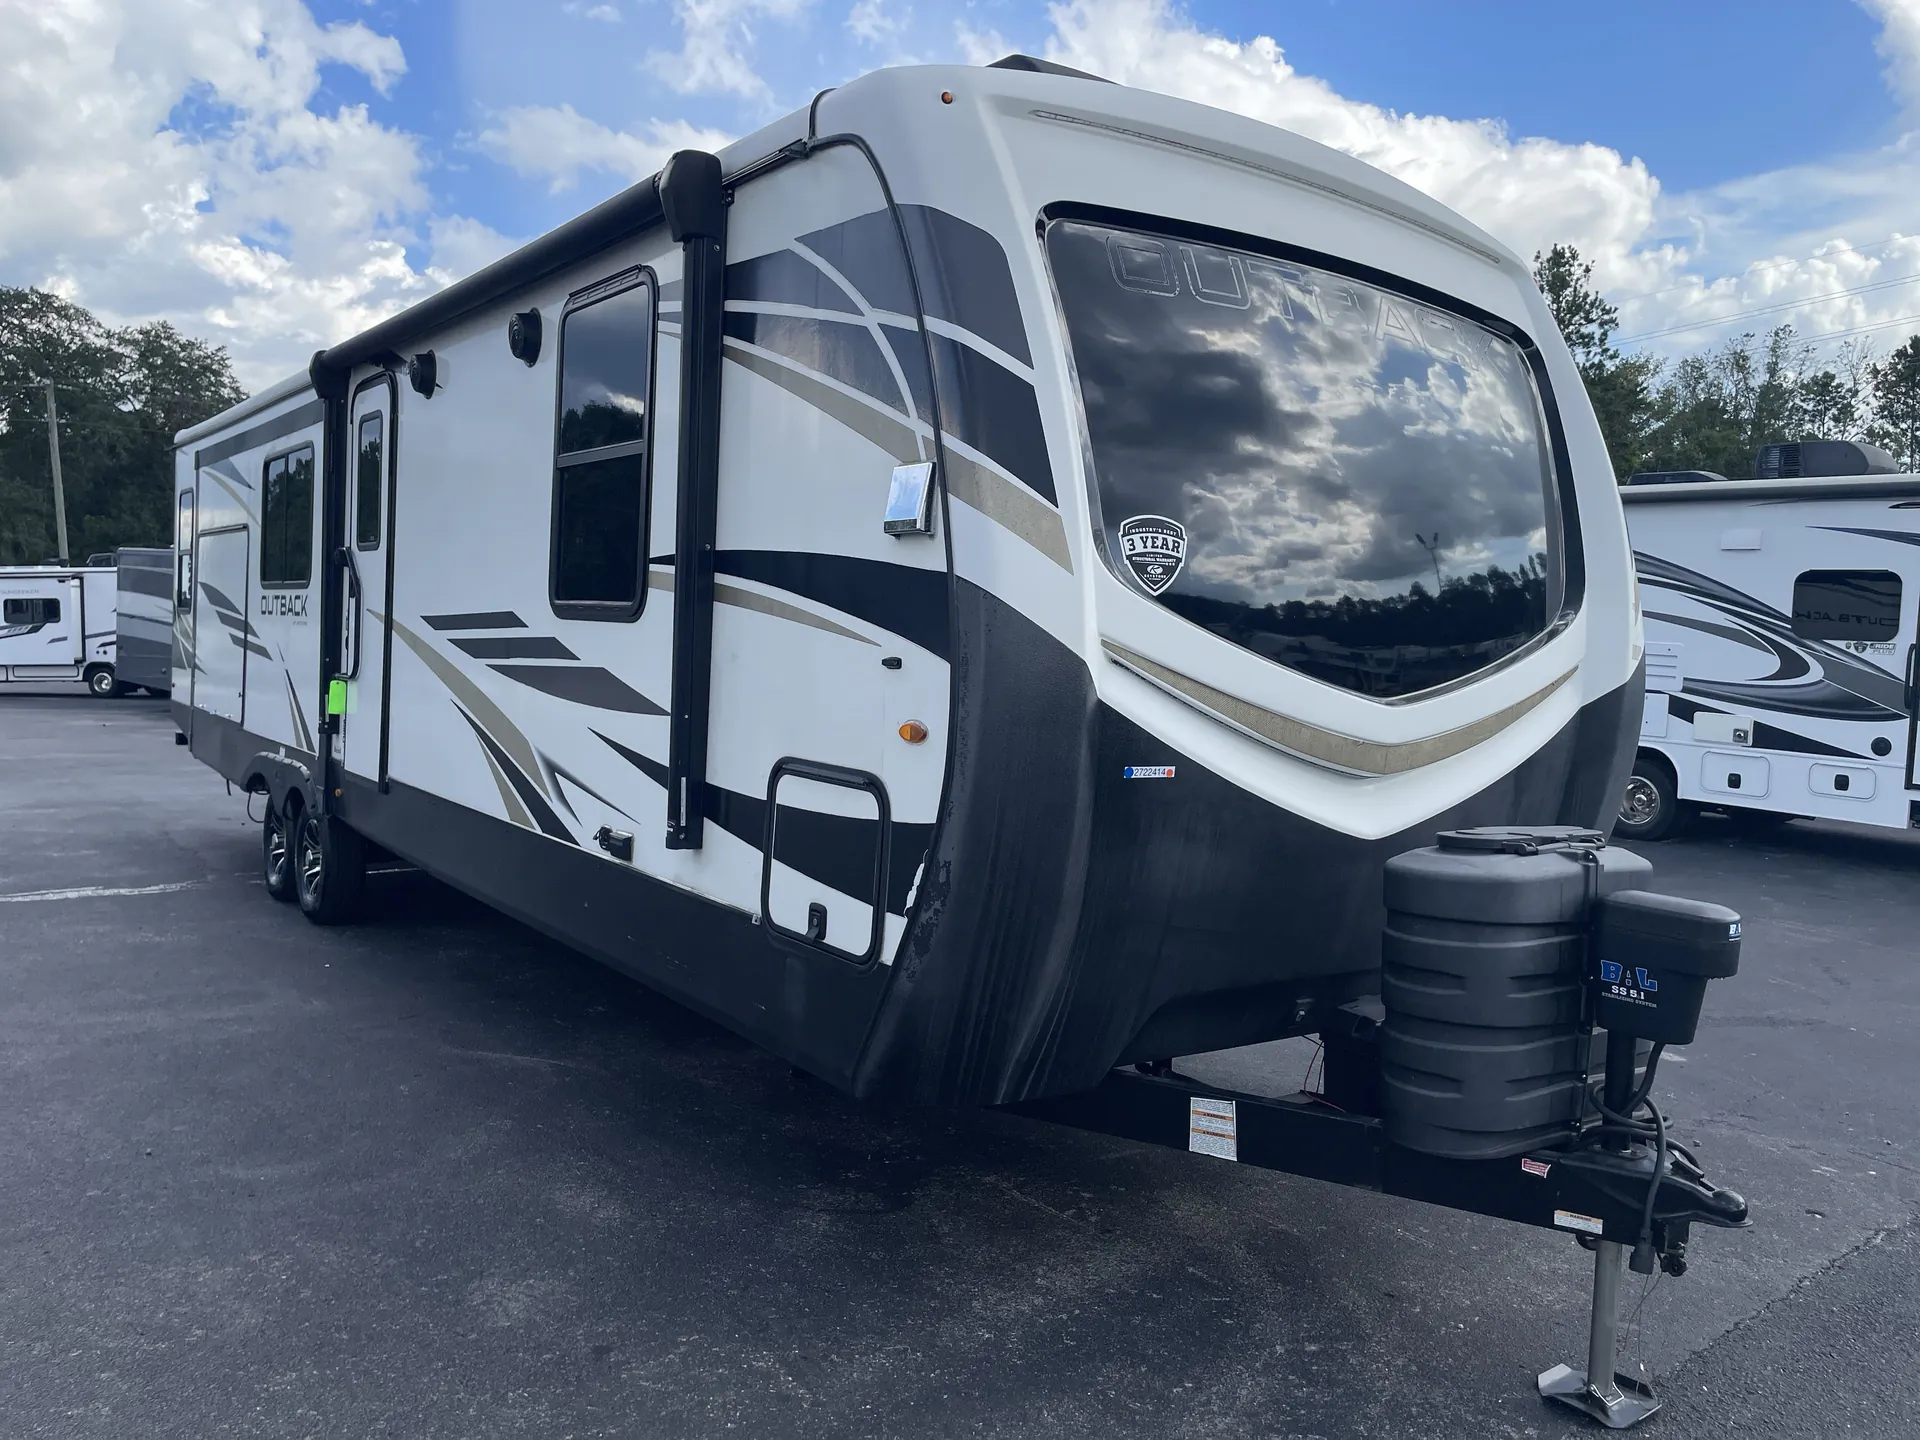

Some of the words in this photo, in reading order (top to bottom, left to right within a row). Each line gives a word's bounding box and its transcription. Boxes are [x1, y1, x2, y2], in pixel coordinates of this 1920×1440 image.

[1105, 235, 1507, 383] OUTBACK
[1126, 538, 1136, 552] 3
[1139, 535, 1181, 554] YEAR
[261, 594, 308, 617] OUTBACK
[1133, 767, 1166, 777] 2722414
[1611, 985, 1627, 996] SS
[1629, 989, 1645, 1000] 5.1
